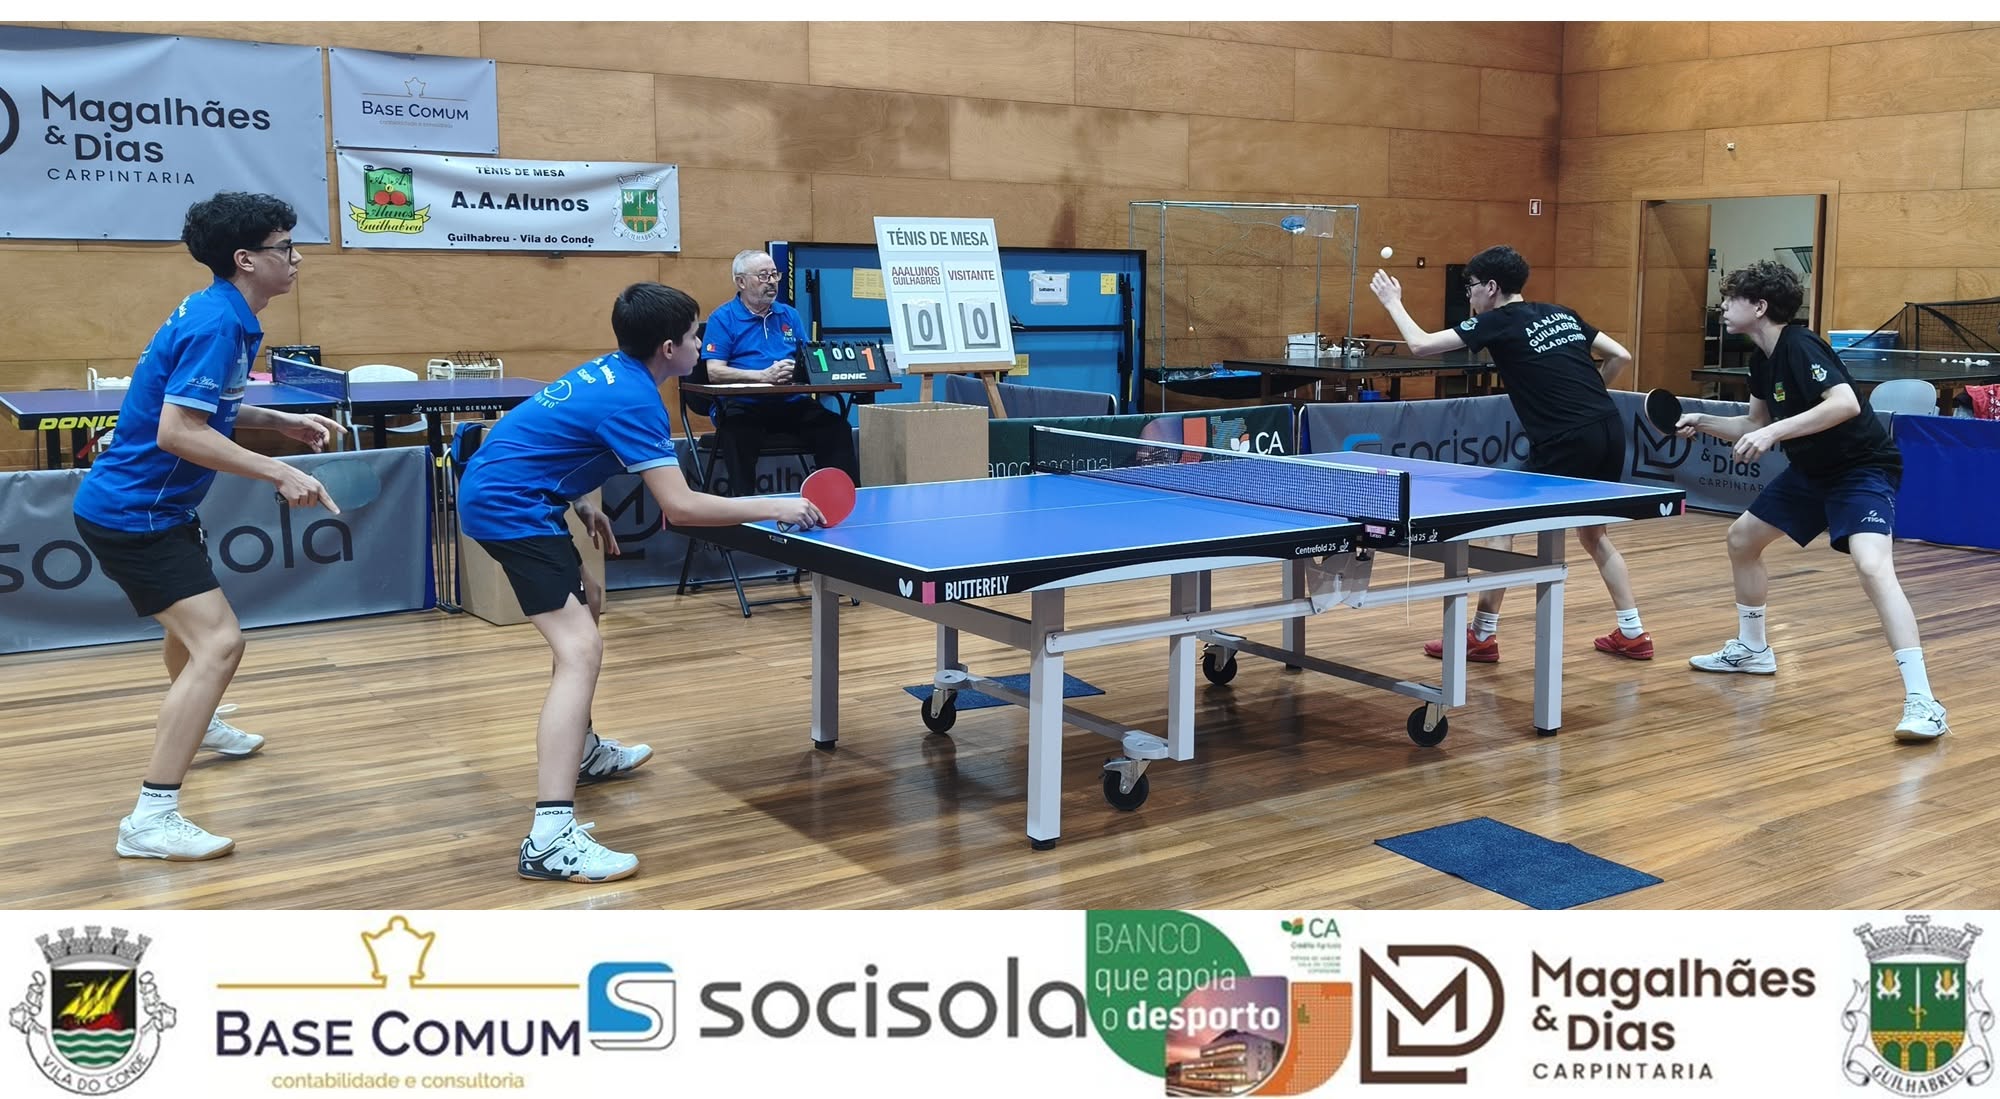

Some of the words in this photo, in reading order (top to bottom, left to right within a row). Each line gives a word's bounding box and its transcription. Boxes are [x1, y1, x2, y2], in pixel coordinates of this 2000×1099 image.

[41, 84, 271, 133] Magalhães
[362, 101, 403, 117] BASE
[408, 104, 469, 121] COMUM
[44, 125, 67, 146] &
[74, 132, 164, 163] Dias
[47, 168, 195, 185] CARPINTARIA
[514, 168, 530, 176] DE
[534, 168, 566, 177] MESA
[451, 191, 589, 212] A.A.Alunos
[447, 233, 510, 243] Guilhabreu
[520, 234, 541, 243] Vila
[544, 235, 557, 244] do
[561, 236, 594, 245] Conde
[886, 228, 928, 246] TÉNIS
[930, 232, 949, 246] DE
[950, 232, 989, 246] MESA
[891, 266, 940, 277] AAALUNOS
[947, 270, 996, 281] VISITANTE
[893, 276, 941, 286] GUILHABREU
[918, 309, 933, 342] 0
[972, 307, 989, 340] 0
[1534, 340, 1557, 354] VILA
[1556, 337, 1568, 346] DO
[812, 348, 829, 372] 1
[861, 347, 876, 371] 1
[831, 372, 868, 381] DONIC
[38, 415, 120, 430] DONIC
[1255, 431, 1285, 455] CA
[1700, 447, 1712, 462] &
[1699, 477, 1765, 492] CARPINTAR
[0, 502, 354, 594] soola
[1295, 544, 1328, 555] Centrefold
[1328, 543, 1337, 552] 25
[945, 576, 1009, 601] BUTTERFLY
